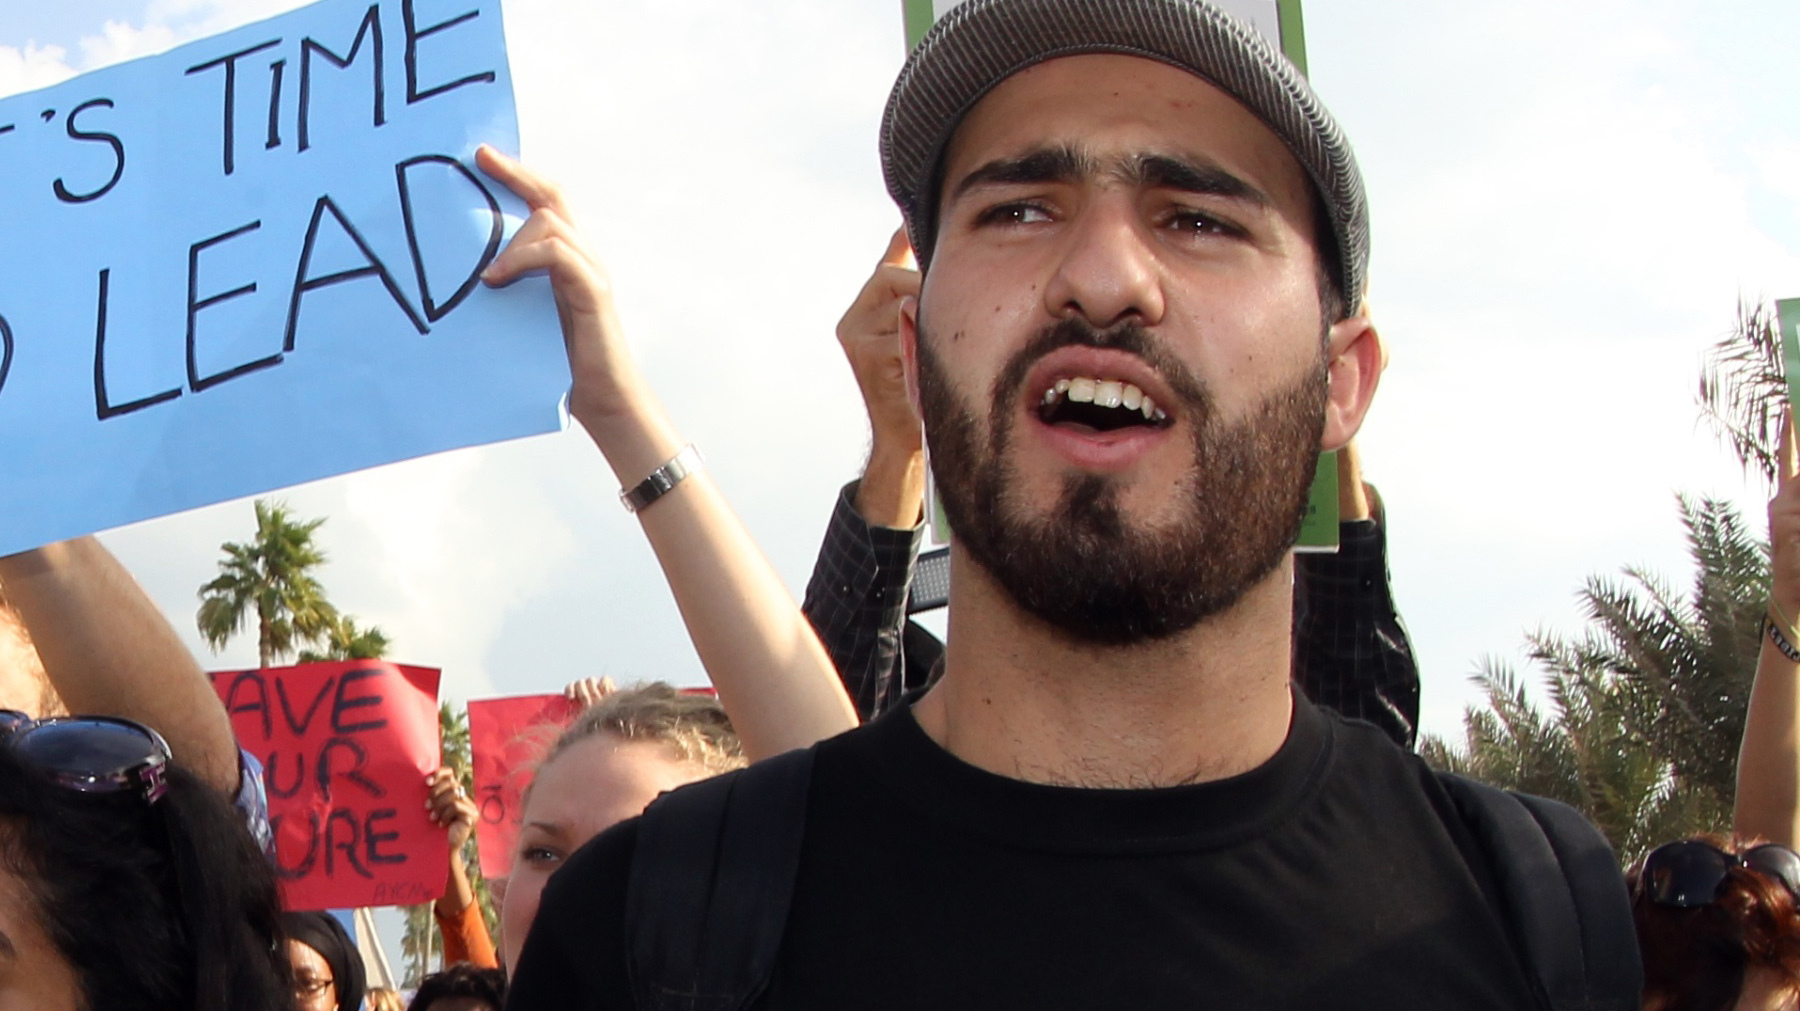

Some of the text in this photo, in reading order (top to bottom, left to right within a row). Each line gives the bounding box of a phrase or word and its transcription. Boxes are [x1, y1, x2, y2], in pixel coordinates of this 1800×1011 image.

[94, 154, 504, 422] LEAD
[210, 668, 387, 740] AVE
[267, 737, 386, 802] UR
